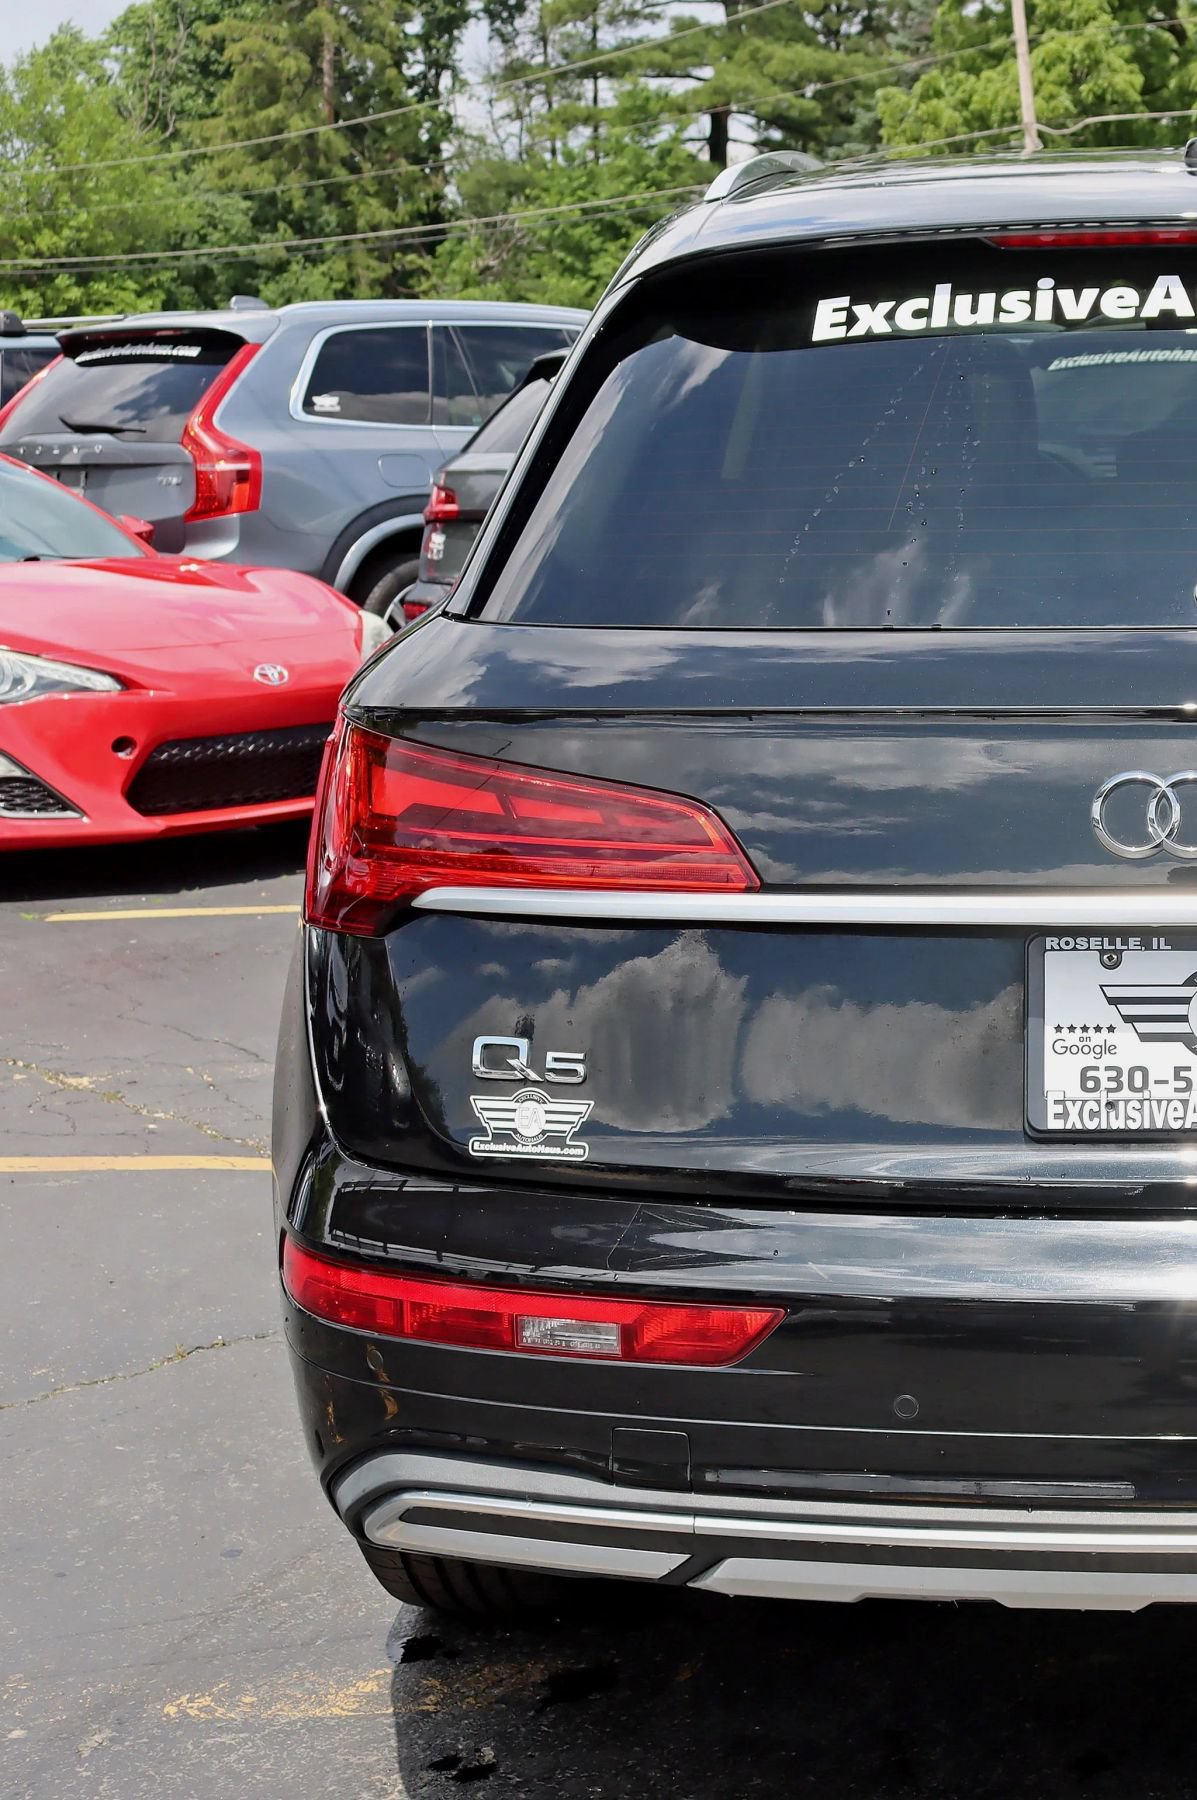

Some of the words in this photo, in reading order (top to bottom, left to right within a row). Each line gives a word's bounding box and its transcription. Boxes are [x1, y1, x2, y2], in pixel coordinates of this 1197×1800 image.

[1045, 936, 1145, 952] ROSELLE,
[1152, 937, 1172, 950] IL
[1079, 1035, 1092, 1043] on
[1052, 1038, 1118, 1060] Google
[472, 1035, 588, 1084] Q5
[473, 1140, 585, 1156] ExclusiveAutoHaus.com
